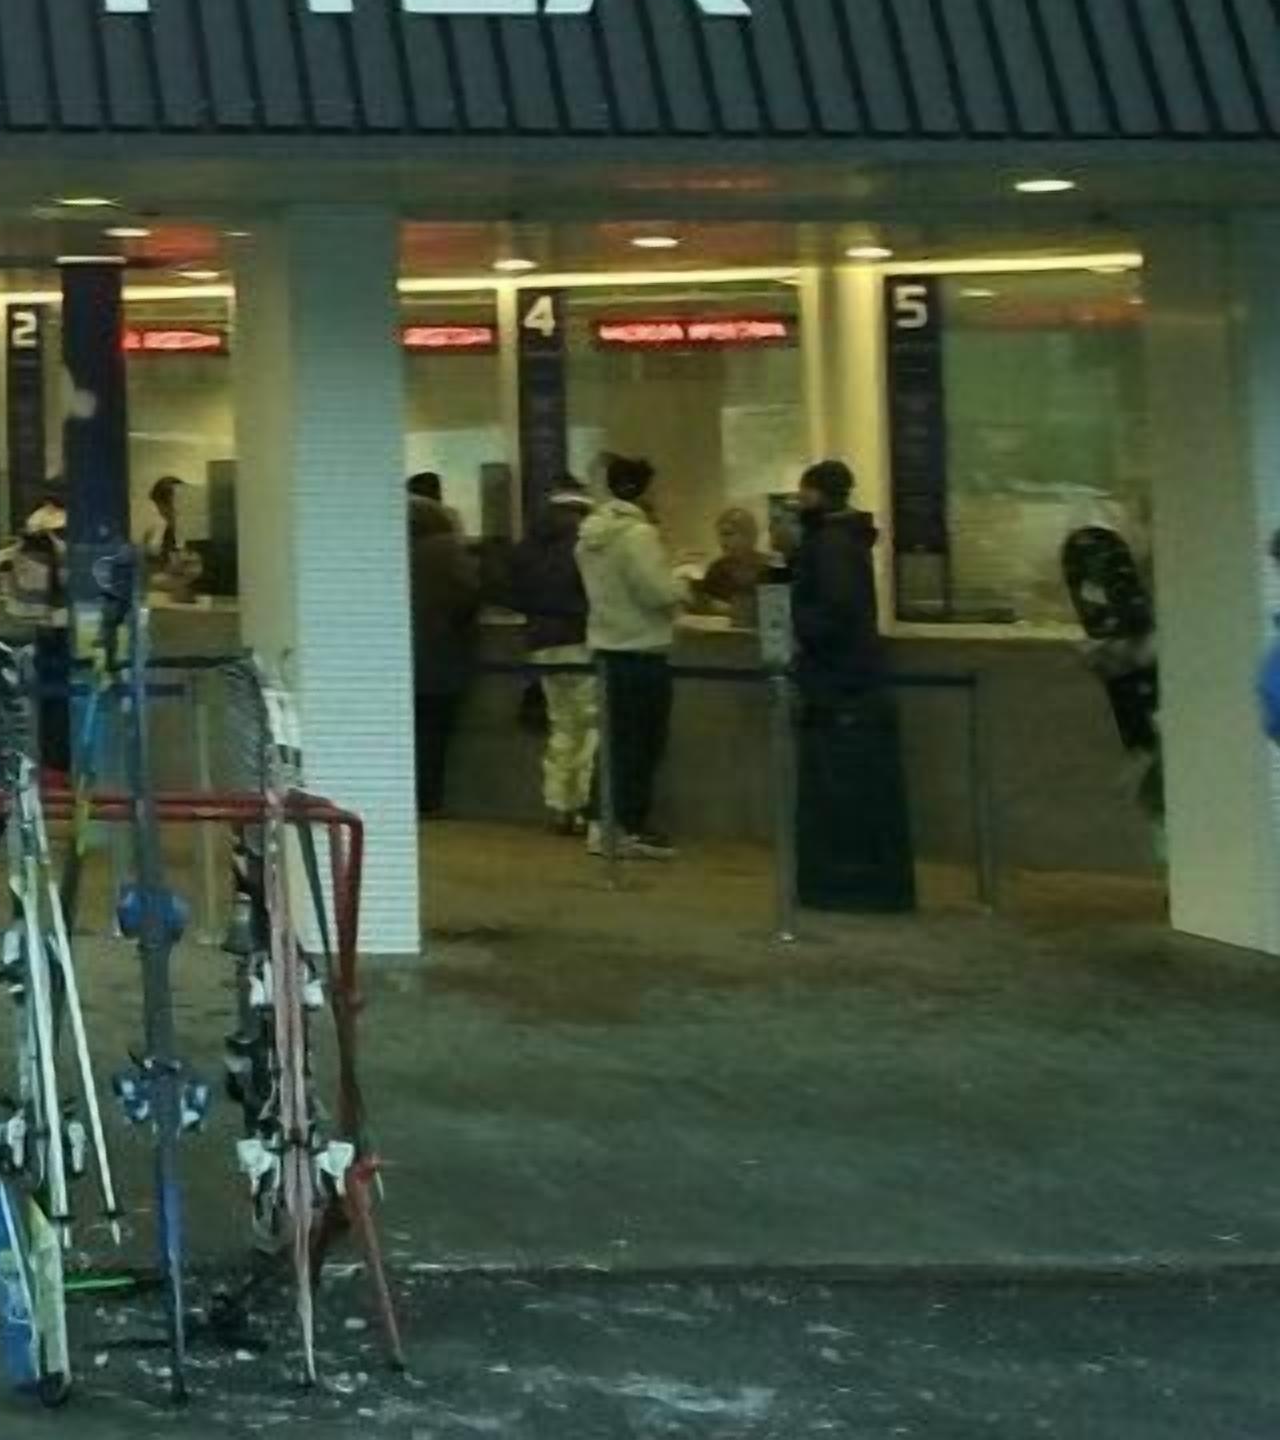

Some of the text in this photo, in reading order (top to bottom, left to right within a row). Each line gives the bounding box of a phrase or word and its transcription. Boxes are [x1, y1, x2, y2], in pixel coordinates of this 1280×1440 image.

[522, 295, 557, 337] 4
[893, 284, 929, 329] 5
[11, 311, 38, 348] 2
